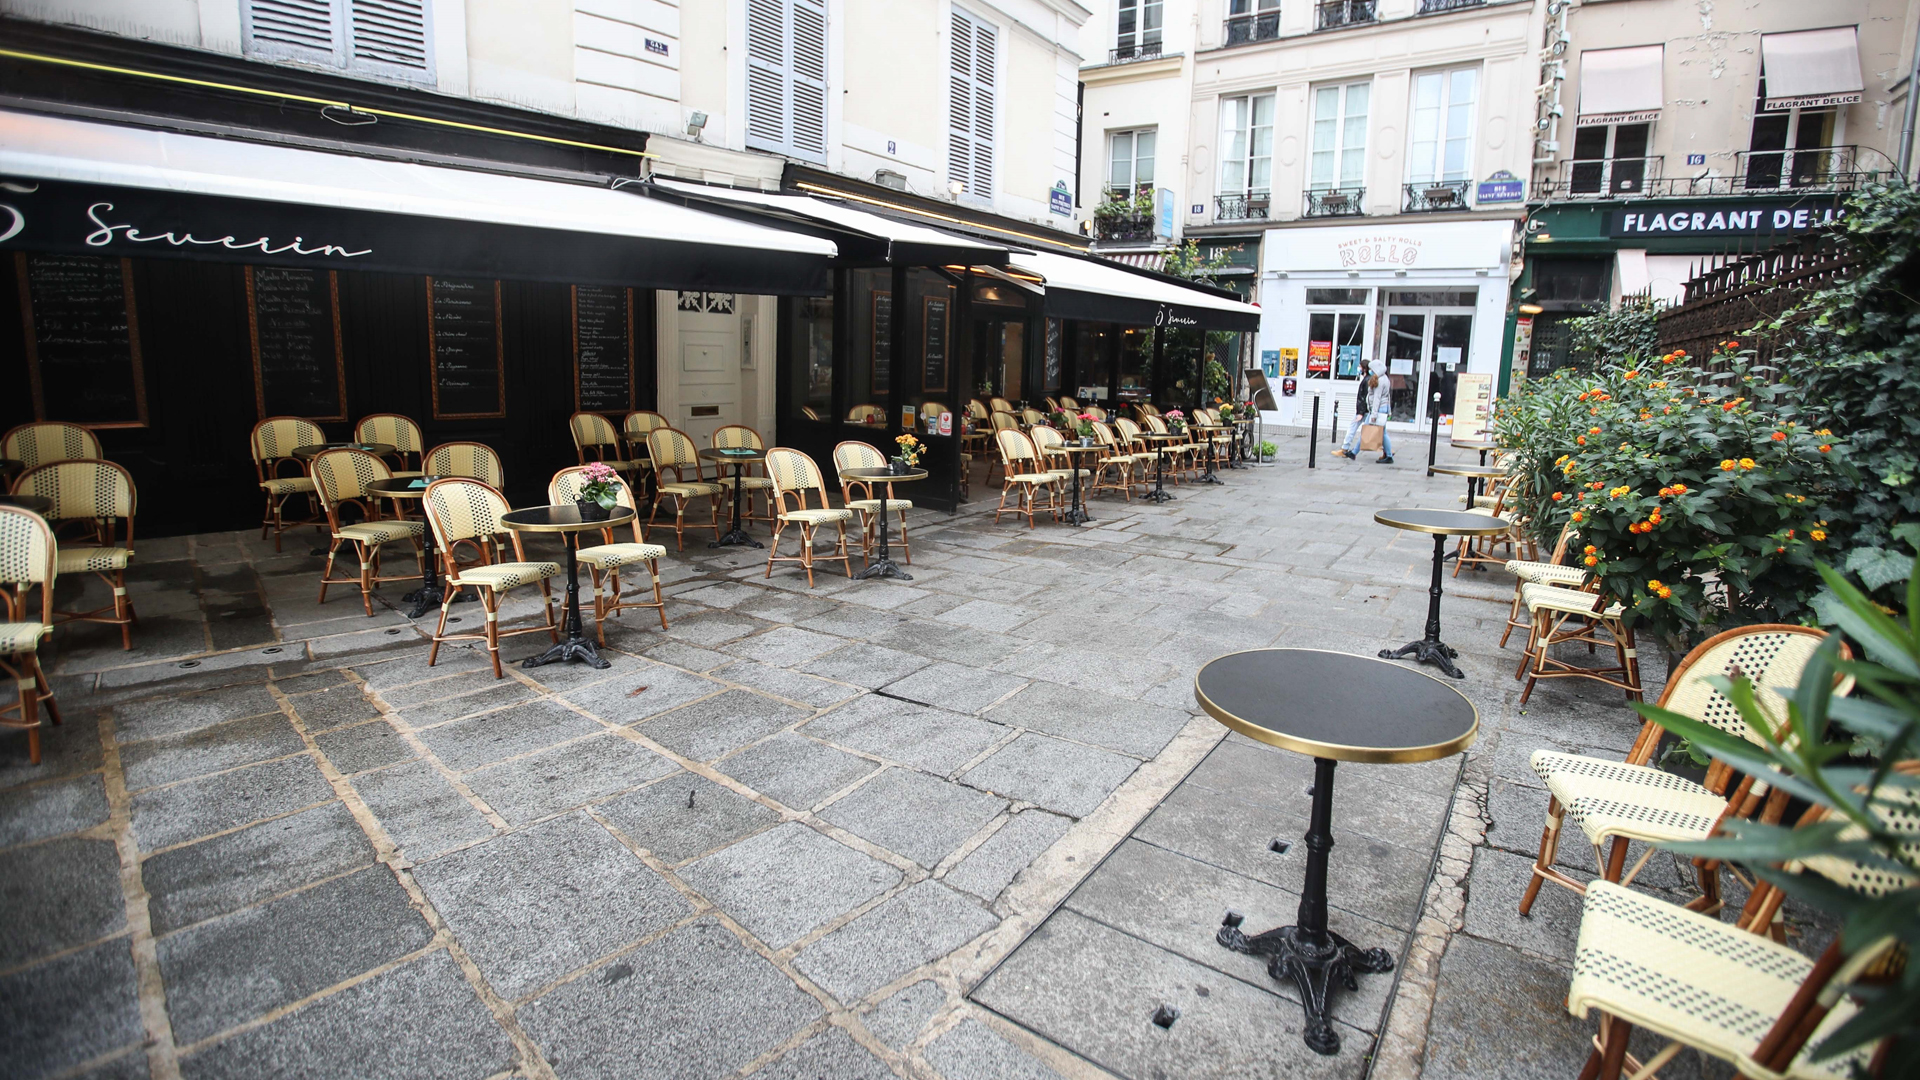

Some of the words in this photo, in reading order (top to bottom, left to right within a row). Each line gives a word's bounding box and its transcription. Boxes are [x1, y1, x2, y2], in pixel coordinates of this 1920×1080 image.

[1766, 99, 1820, 109] FLAGRANT
[1823, 95, 1860, 105] DELICE
[1580, 116, 1625, 125] FLAGRANT
[1628, 113, 1659, 121] DELICE
[889, 141, 895, 154] 2
[1690, 155, 1702, 165] 16
[1194, 205, 1202, 213] 18
[1623, 210, 1763, 232] FLAGRANT
[85, 202, 372, 258] Severin
[1338, 238, 1362, 249] SWEET
[1398, 237, 1422, 247] ROLLS
[1209, 247, 1223, 260] 18
[1339, 244, 1418, 267] ROLLO
